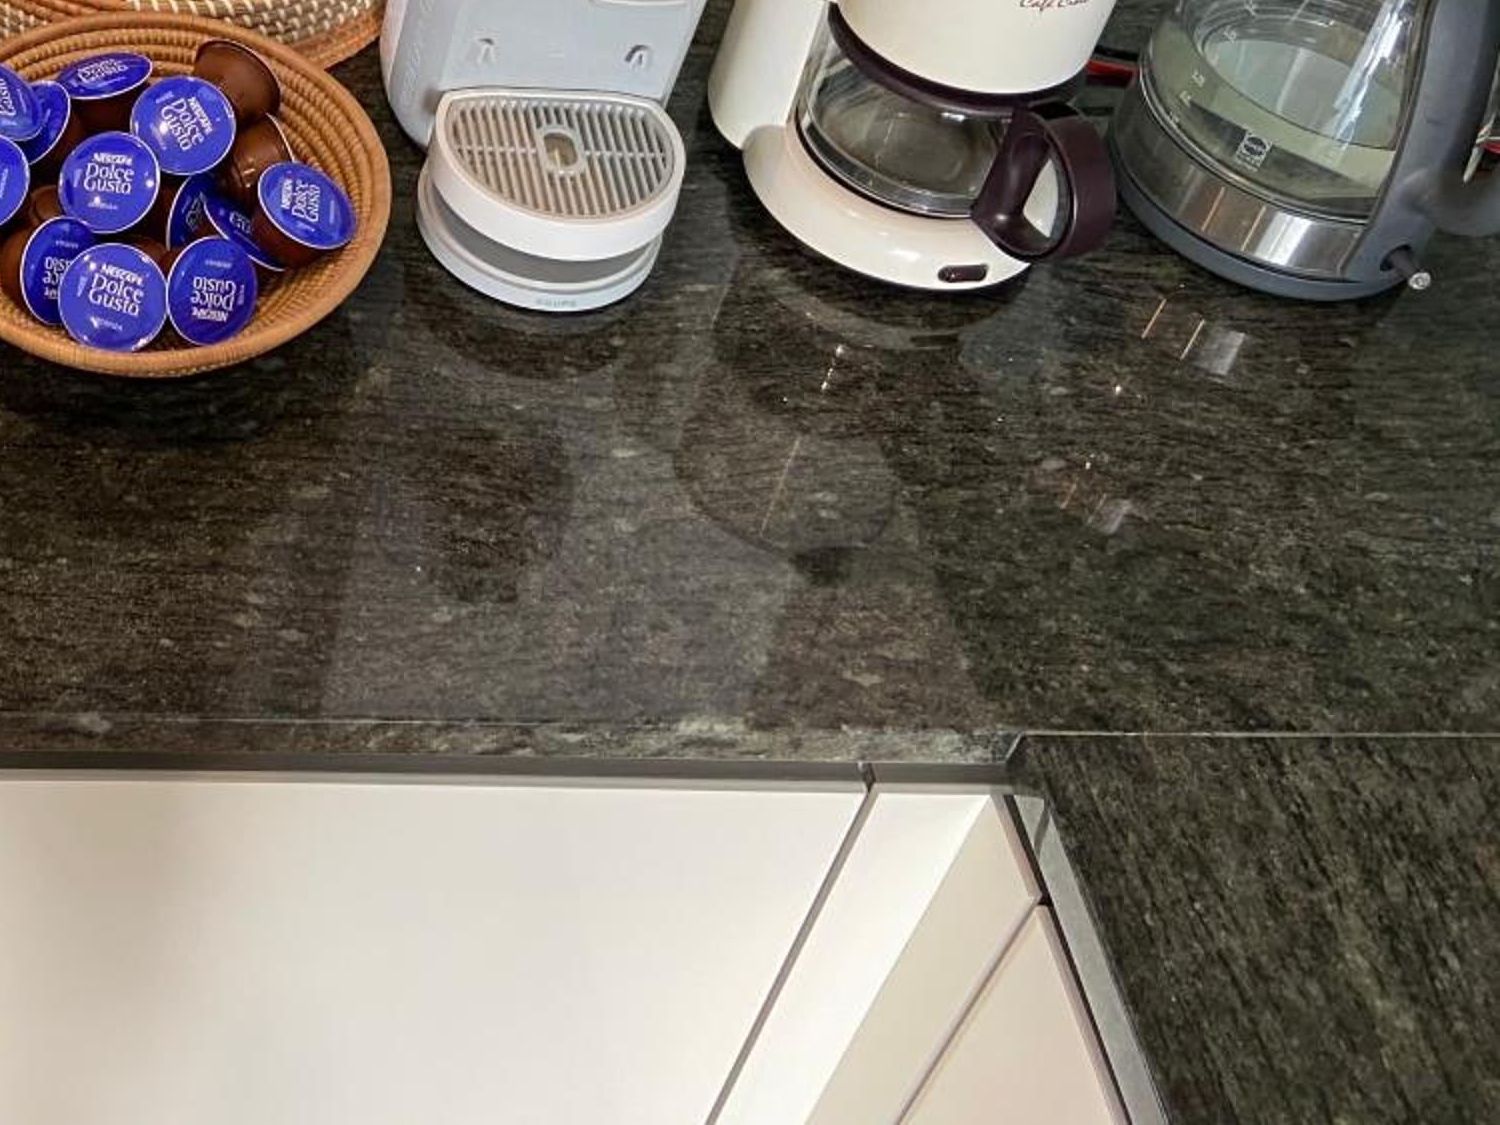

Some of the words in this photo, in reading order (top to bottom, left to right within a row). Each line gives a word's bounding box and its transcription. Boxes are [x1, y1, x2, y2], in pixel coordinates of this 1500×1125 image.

[161, 106, 193, 152] Gusto
[171, 98, 205, 146] Dolce
[83, 177, 132, 194] Gusto
[85, 162, 134, 182] Dolce
[292, 179, 310, 219] Dolce
[91, 272, 144, 304] Dolce
[192, 277, 237, 296] Gusto
[88, 288, 140, 316] Gusto
[190, 291, 235, 311] Dolce
